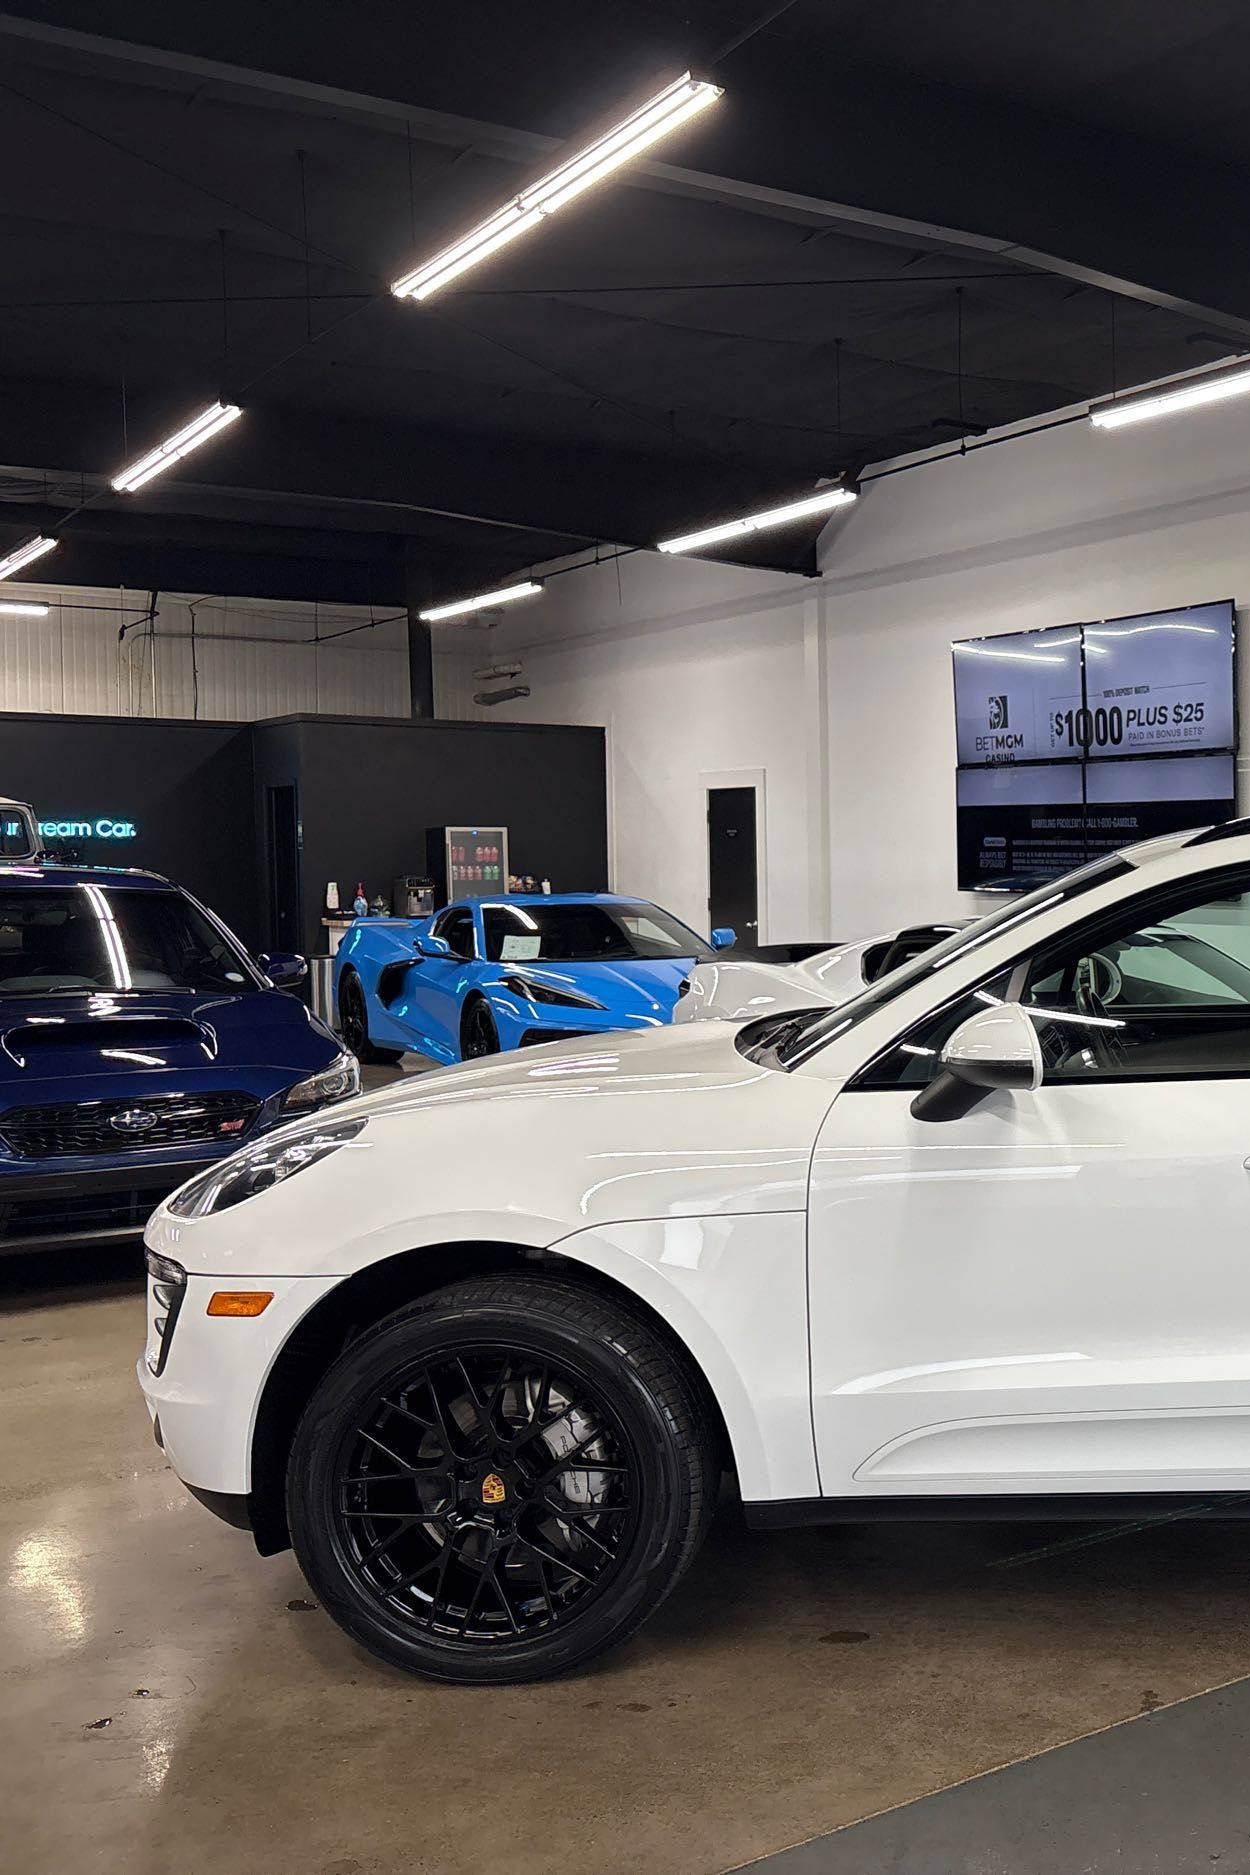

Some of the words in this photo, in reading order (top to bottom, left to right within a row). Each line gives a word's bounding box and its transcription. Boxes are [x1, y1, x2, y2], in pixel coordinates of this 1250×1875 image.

[1055, 706, 1122, 747] $1000
[1126, 706, 1168, 728] PLUS
[1172, 702, 1205, 726] $25
[975, 733, 1024, 752] BETMGM
[1128, 732, 1144, 741] PAID
[1146, 731, 1154, 739] IN
[1156, 729, 1181, 739] BONUS
[985, 752, 1015, 764] CASINO
[37, 821, 92, 837] ream
[96, 819, 137, 838] Car.
